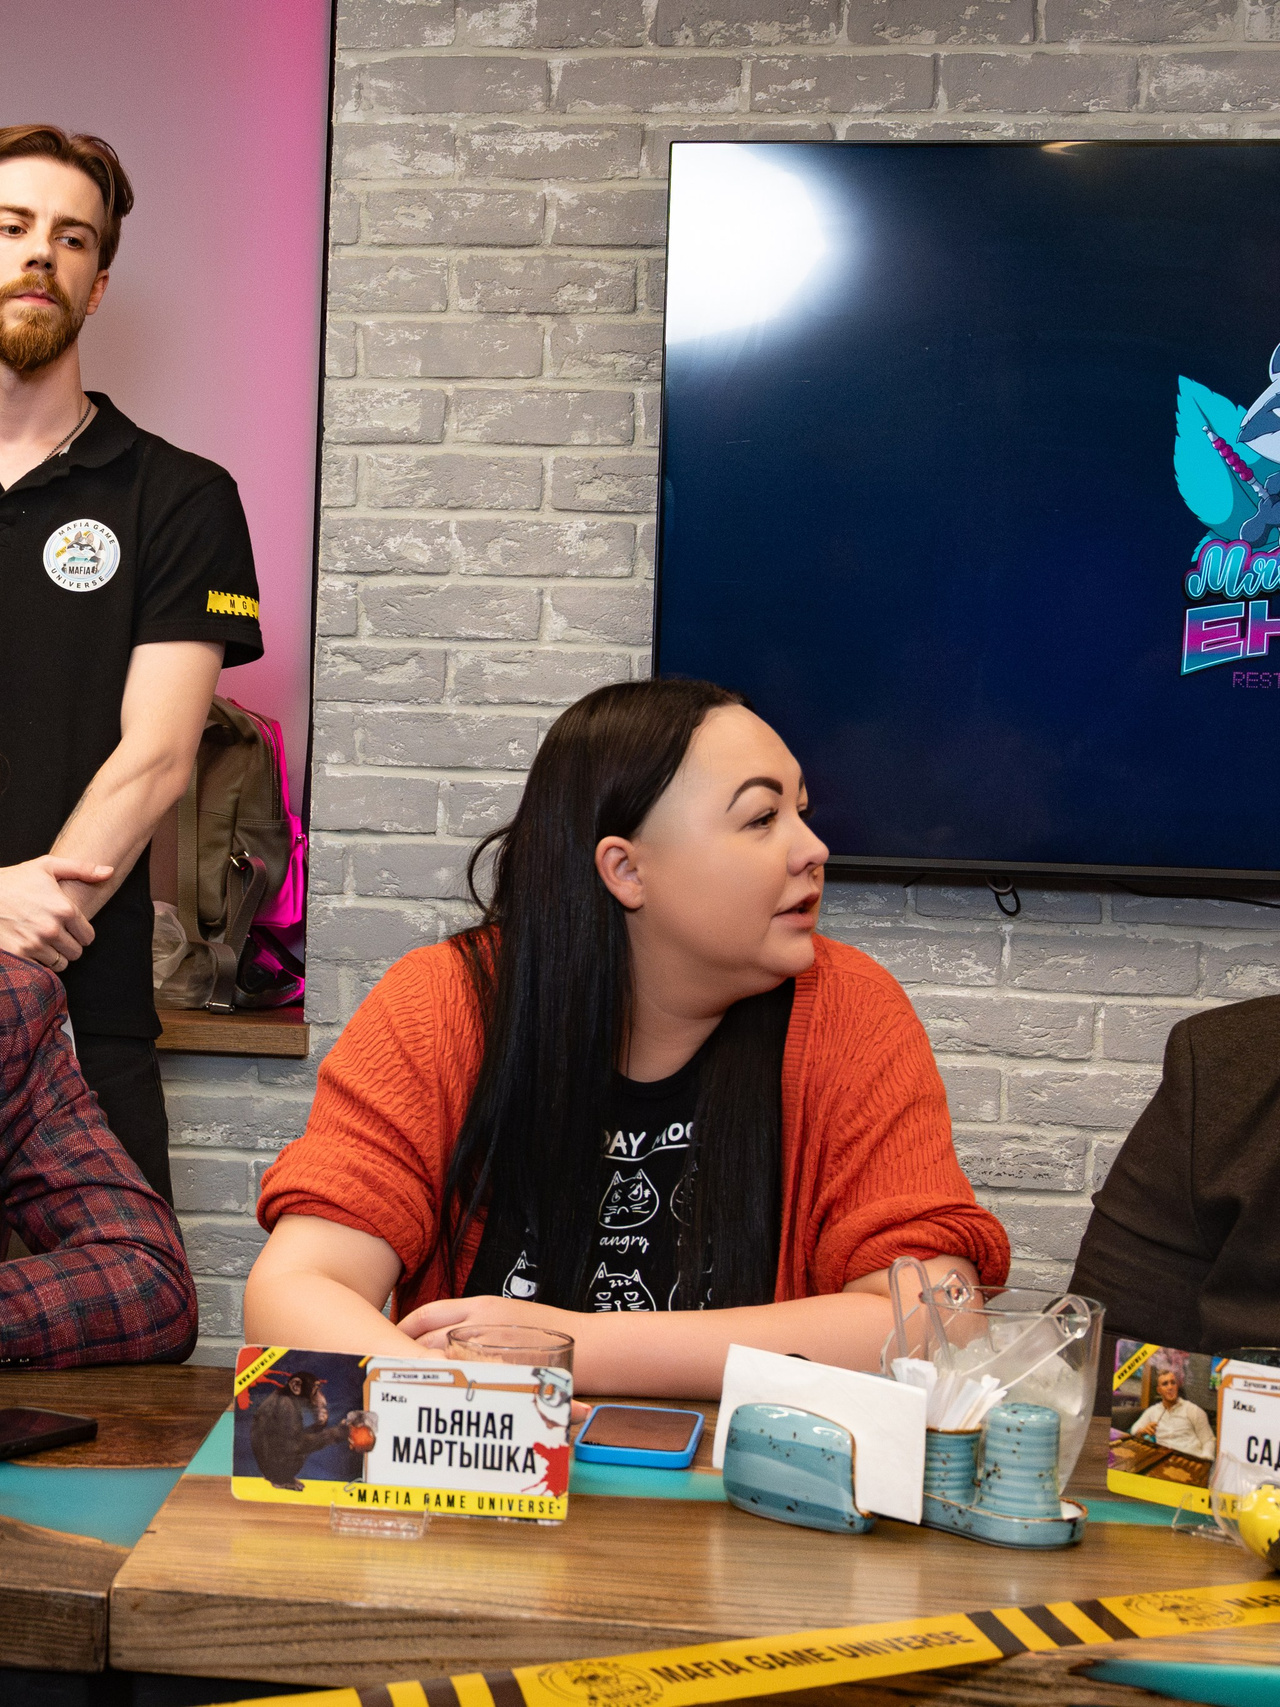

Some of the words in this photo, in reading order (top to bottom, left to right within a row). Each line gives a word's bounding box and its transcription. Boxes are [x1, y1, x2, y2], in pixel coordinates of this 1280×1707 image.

[58, 522, 90, 536] MAFIA
[93, 524, 116, 545] GAME
[51, 568, 106, 589] UNIVERSE
[68, 566, 91, 575] MAFIA
[1185, 545, 1280, 598] Мя
[599, 1235, 650, 1255] angry
[417, 1406, 514, 1441] ПЬЯНАЯ
[392, 1436, 537, 1474] МАРТЫШКА
[1247, 1436, 1280, 1471] СА
[357, 1489, 411, 1505] MAFIA
[424, 1493, 466, 1509] GAME
[477, 1496, 554, 1514] UNIVERSE
[650, 1659, 752, 1684] MAFIA
[745, 1646, 835, 1671] GAME
[826, 1631, 975, 1659] UNIVERSE
